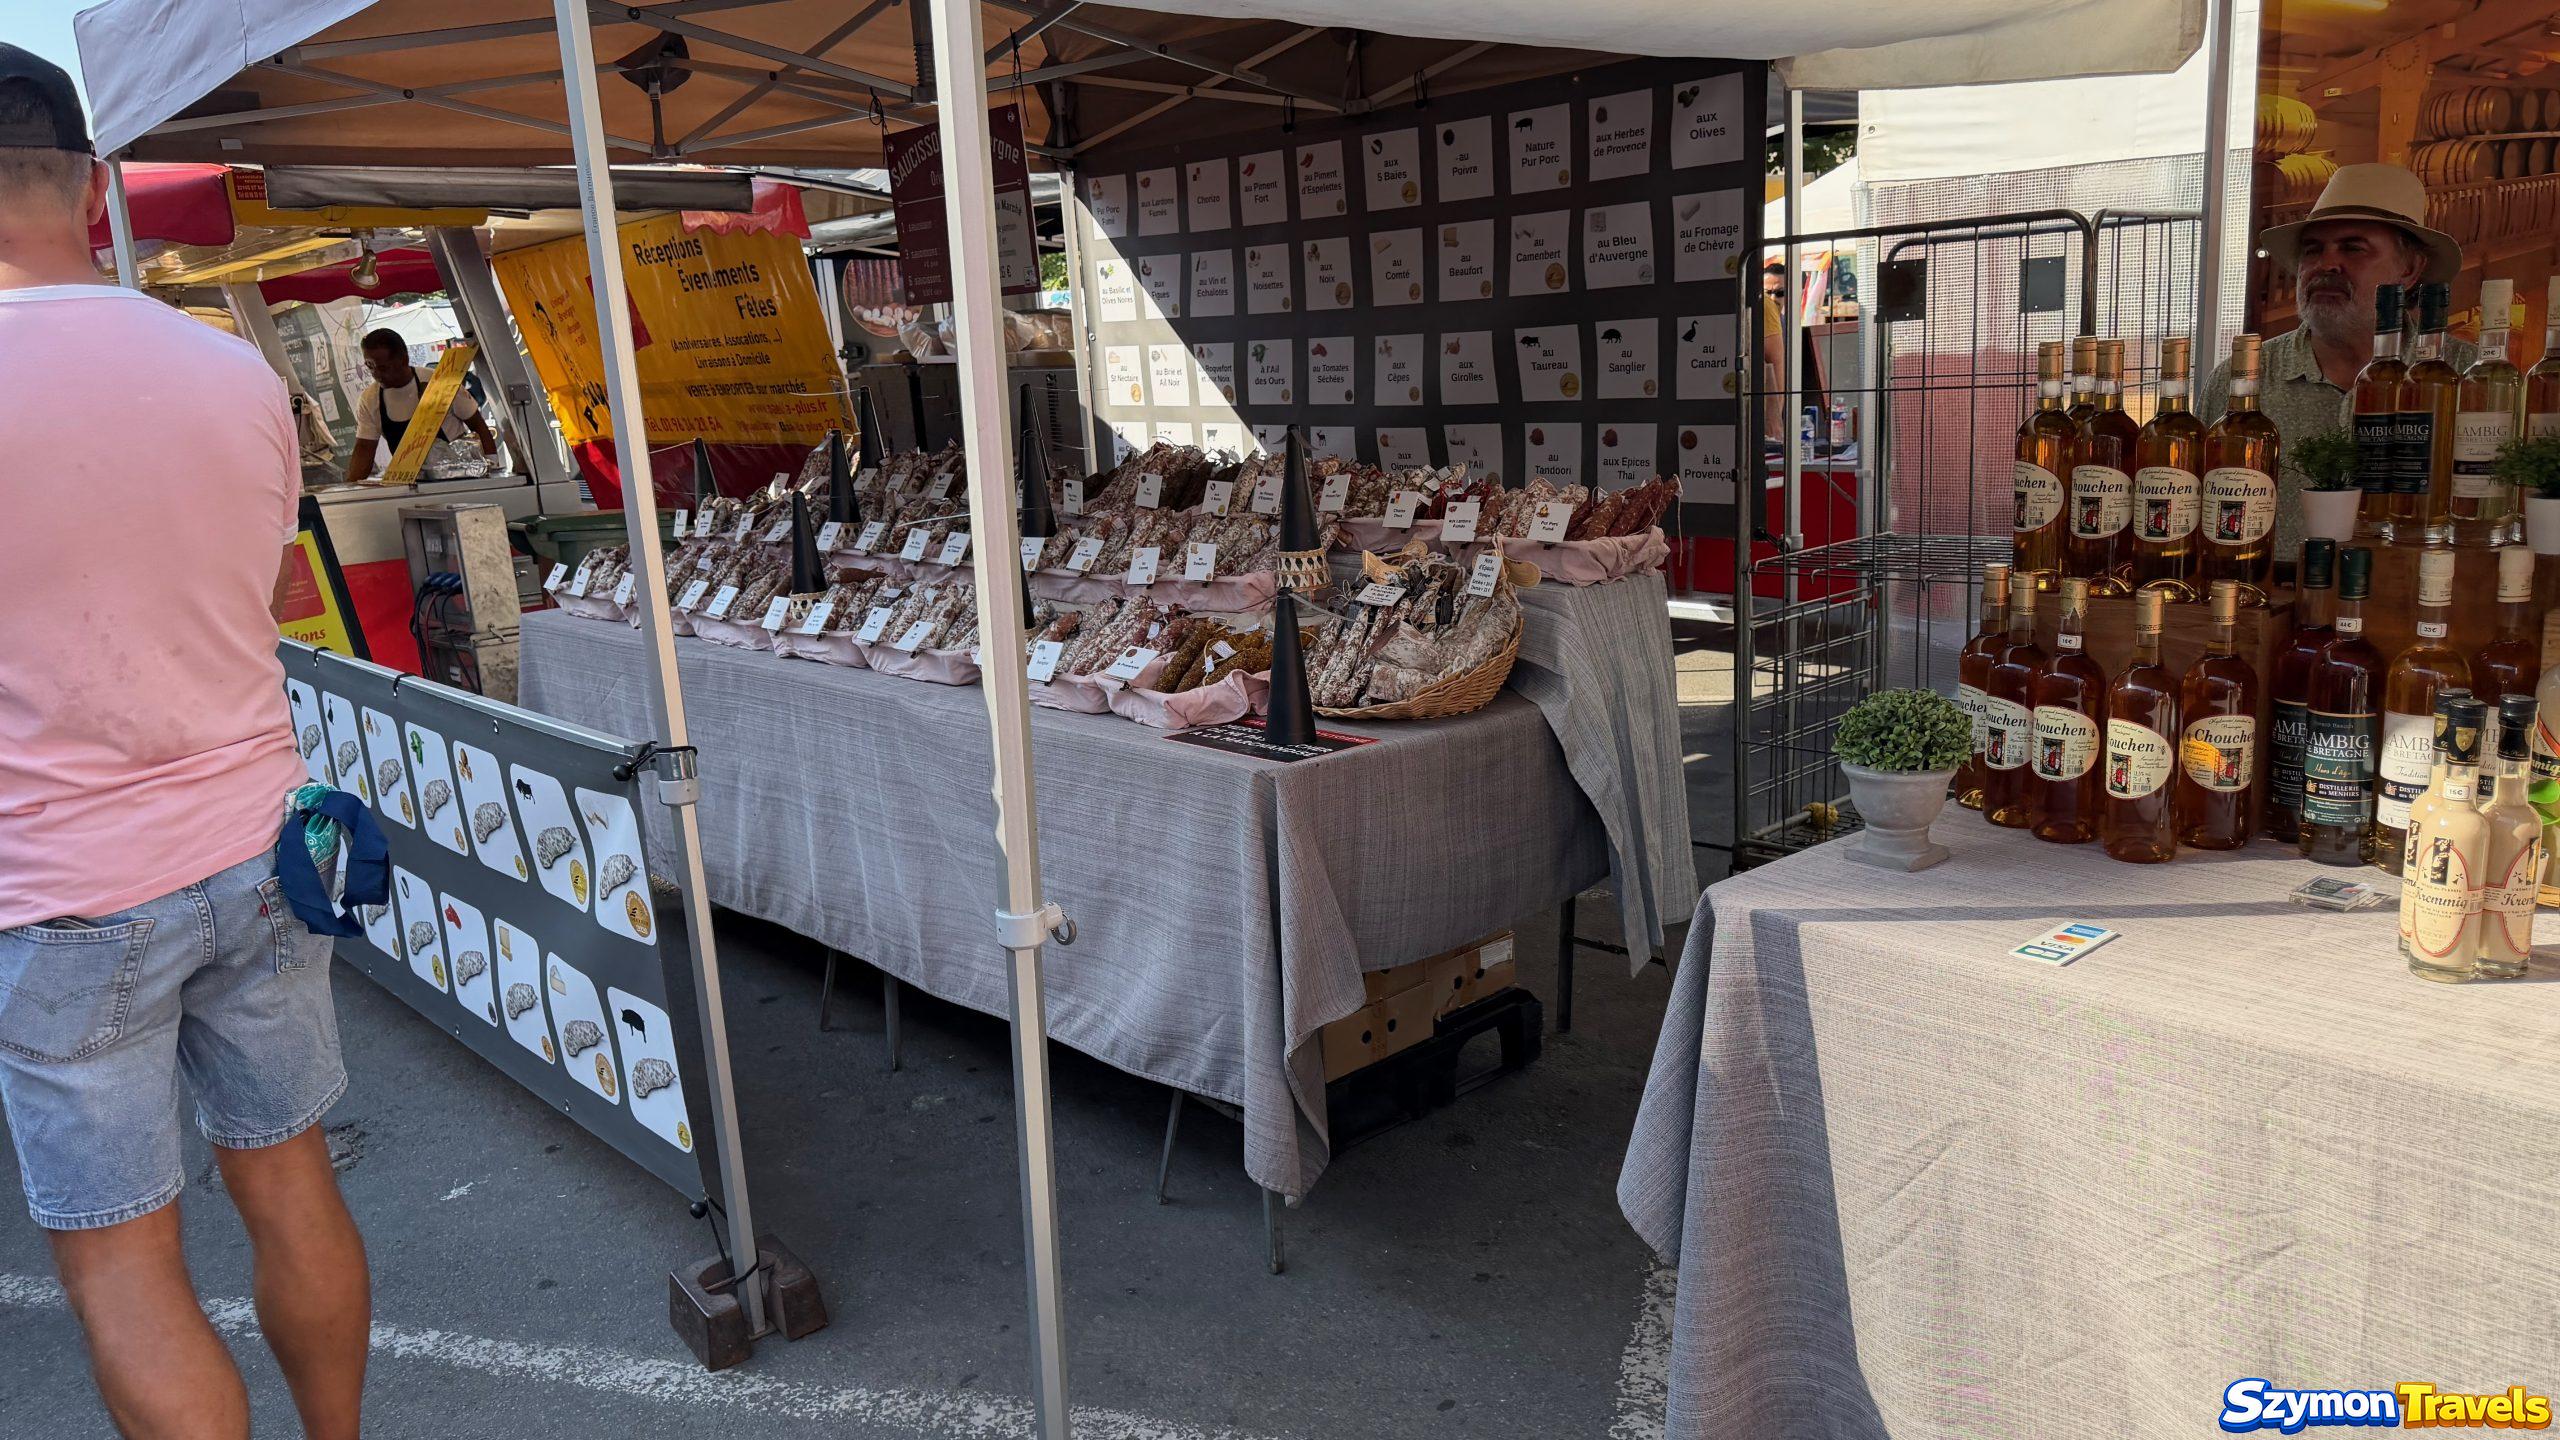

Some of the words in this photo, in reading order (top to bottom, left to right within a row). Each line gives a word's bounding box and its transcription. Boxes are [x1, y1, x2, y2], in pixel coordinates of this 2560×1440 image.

[1696, 113, 1718, 122] aux
[1596, 134, 1610, 143] aux
[1614, 128, 1646, 140] Herbes
[1690, 127, 1726, 140] Olives
[992, 137, 1020, 164] rgne
[1525, 141, 1555, 152] Nature
[1594, 148, 1604, 157] de
[1606, 141, 1648, 156] Provence
[891, 131, 941, 189] SAUCISSO
[1458, 153, 1469, 161] au
[1522, 157, 1536, 168] Pur
[1539, 154, 1559, 166] Porc
[1384, 159, 1399, 168] aux
[1314, 170, 1338, 181] Piment
[1384, 170, 1408, 180] Baies
[1452, 166, 1478, 176] Poivre
[1253, 181, 1278, 191] Piment
[1196, 195, 1220, 204] Chorizo
[1254, 194, 1270, 204] Fort
[1680, 230, 1692, 239] au
[1694, 224, 1739, 237] Fromage
[1534, 238, 1544, 246] au
[1597, 240, 1610, 248] au
[1612, 235, 1637, 246] Bleu
[1684, 243, 1696, 254] de
[1699, 240, 1735, 252] Chèvre
[632, 236, 704, 267] Réceptions
[1589, 248, 1648, 264] d'Auvergne
[1392, 259, 1402, 268] au
[1461, 254, 1471, 262] au
[1319, 264, 1333, 272] aux
[1448, 266, 1483, 278] Beaufort
[1262, 270, 1274, 278] aux
[1319, 274, 1335, 284] Noix
[1385, 270, 1410, 280] Comté
[1253, 281, 1284, 290] Noisettes
[736, 292, 778, 320] Fêtes
[1542, 349, 1554, 358] au
[1621, 350, 1632, 358] au
[1703, 345, 1715, 354] au
[736, 351, 772, 367] Domicile
[1691, 358, 1728, 369] Canard
[1322, 364, 1349, 372] Tomates
[1392, 362, 1406, 370] aux
[1458, 361, 1474, 370] aux
[1532, 360, 1568, 372] Taureau
[1608, 362, 1646, 374] Sanglier
[1254, 376, 1267, 385] des
[1268, 376, 1286, 385] Ours
[1317, 375, 1345, 384] Séchées
[1387, 372, 1410, 382] Cèpes
[1450, 373, 1484, 382] Girolles
[686, 384, 709, 398] VENTE
[717, 382, 754, 396] EMPORTER
[770, 378, 808, 395] marchés
[2396, 424, 2430, 436] MBIG
[2456, 424, 2508, 437] LAMBIG
[2532, 425, 2560, 437] LAM
[1473, 448, 1478, 457] à
[1548, 454, 1559, 462] au
[1603, 458, 1619, 466] aux
[1622, 458, 1650, 468] Epices
[1703, 454, 1710, 464] à
[1712, 454, 1721, 464] la
[1468, 460, 1484, 470] l'Ail
[1534, 465, 1572, 476] Tandoori
[1684, 468, 1734, 481] Provença
[2015, 476, 2047, 490] uchen
[2073, 480, 2123, 494] houchen
[2134, 480, 2193, 496] Chouchen
[2204, 480, 2268, 498] Chouchen
[1987, 712, 2027, 728] ouchen
[2036, 718, 2086, 736] houchen
[2272, 719, 2306, 737] AMB
[2194, 728, 2256, 744] Chouche
[2278, 733, 2306, 744] BRETA
[2306, 731, 2370, 749] AMBIG
[2384, 730, 2432, 752] LAMB
[2109, 737, 2155, 754] ouchen
[2312, 746, 2370, 758] BRETAGNE
[2394, 749, 2432, 760] BRETA
[2398, 765, 2428, 779] Tradition
[2318, 783, 2360, 792] DISTILLERIE
[2398, 786, 2427, 794] DISTILL
[2328, 790, 2360, 798] MENHIRS
[2040, 940, 2076, 952] VISA
